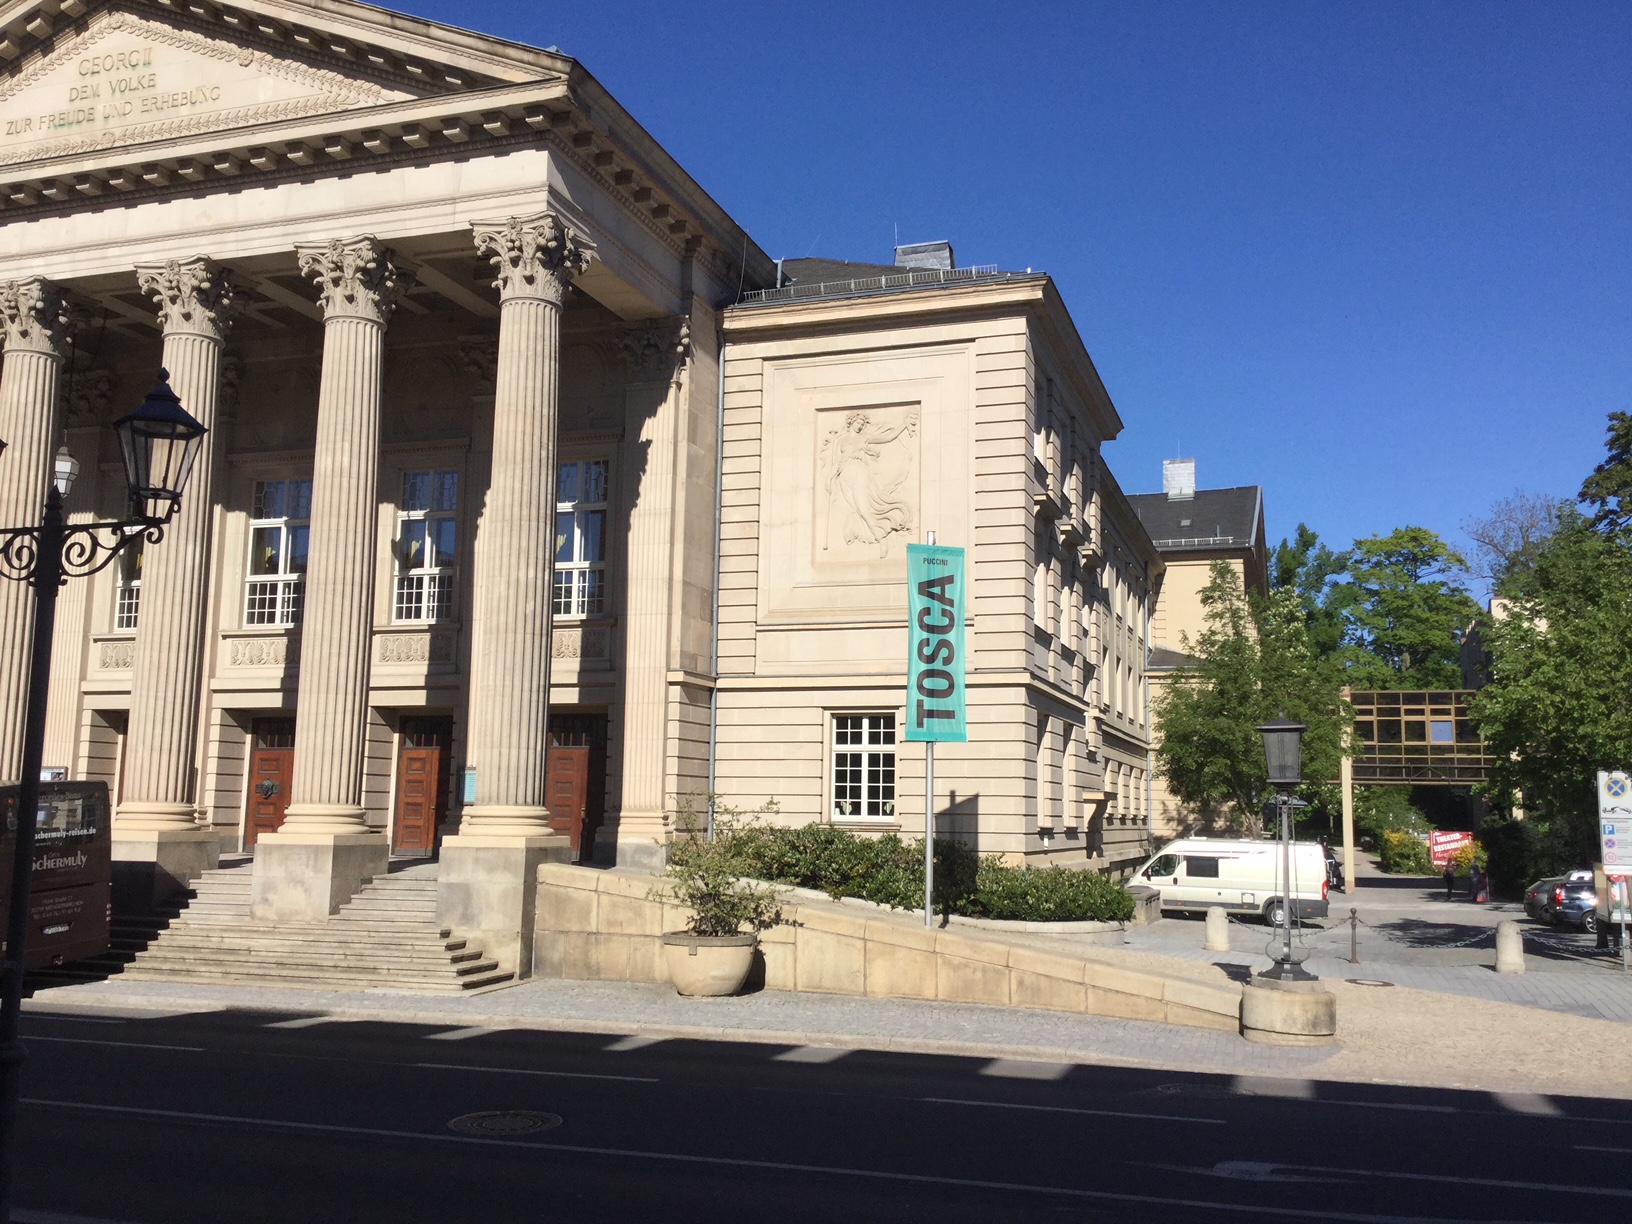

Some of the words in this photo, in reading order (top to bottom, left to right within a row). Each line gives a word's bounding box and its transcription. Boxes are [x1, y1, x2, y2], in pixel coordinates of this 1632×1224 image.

[78, 49, 140, 76] GEORG
[69, 83, 100, 102] DEM
[109, 73, 156, 94] VOLKE
[6, 119, 33, 136] ZUR
[38, 107, 95, 130] FREUDE
[103, 101, 133, 119] UND
[140, 86, 221, 113] ERHEBUNG
[922, 557, 948, 566] PUCCINI
[916, 574, 956, 728] TOSCA
